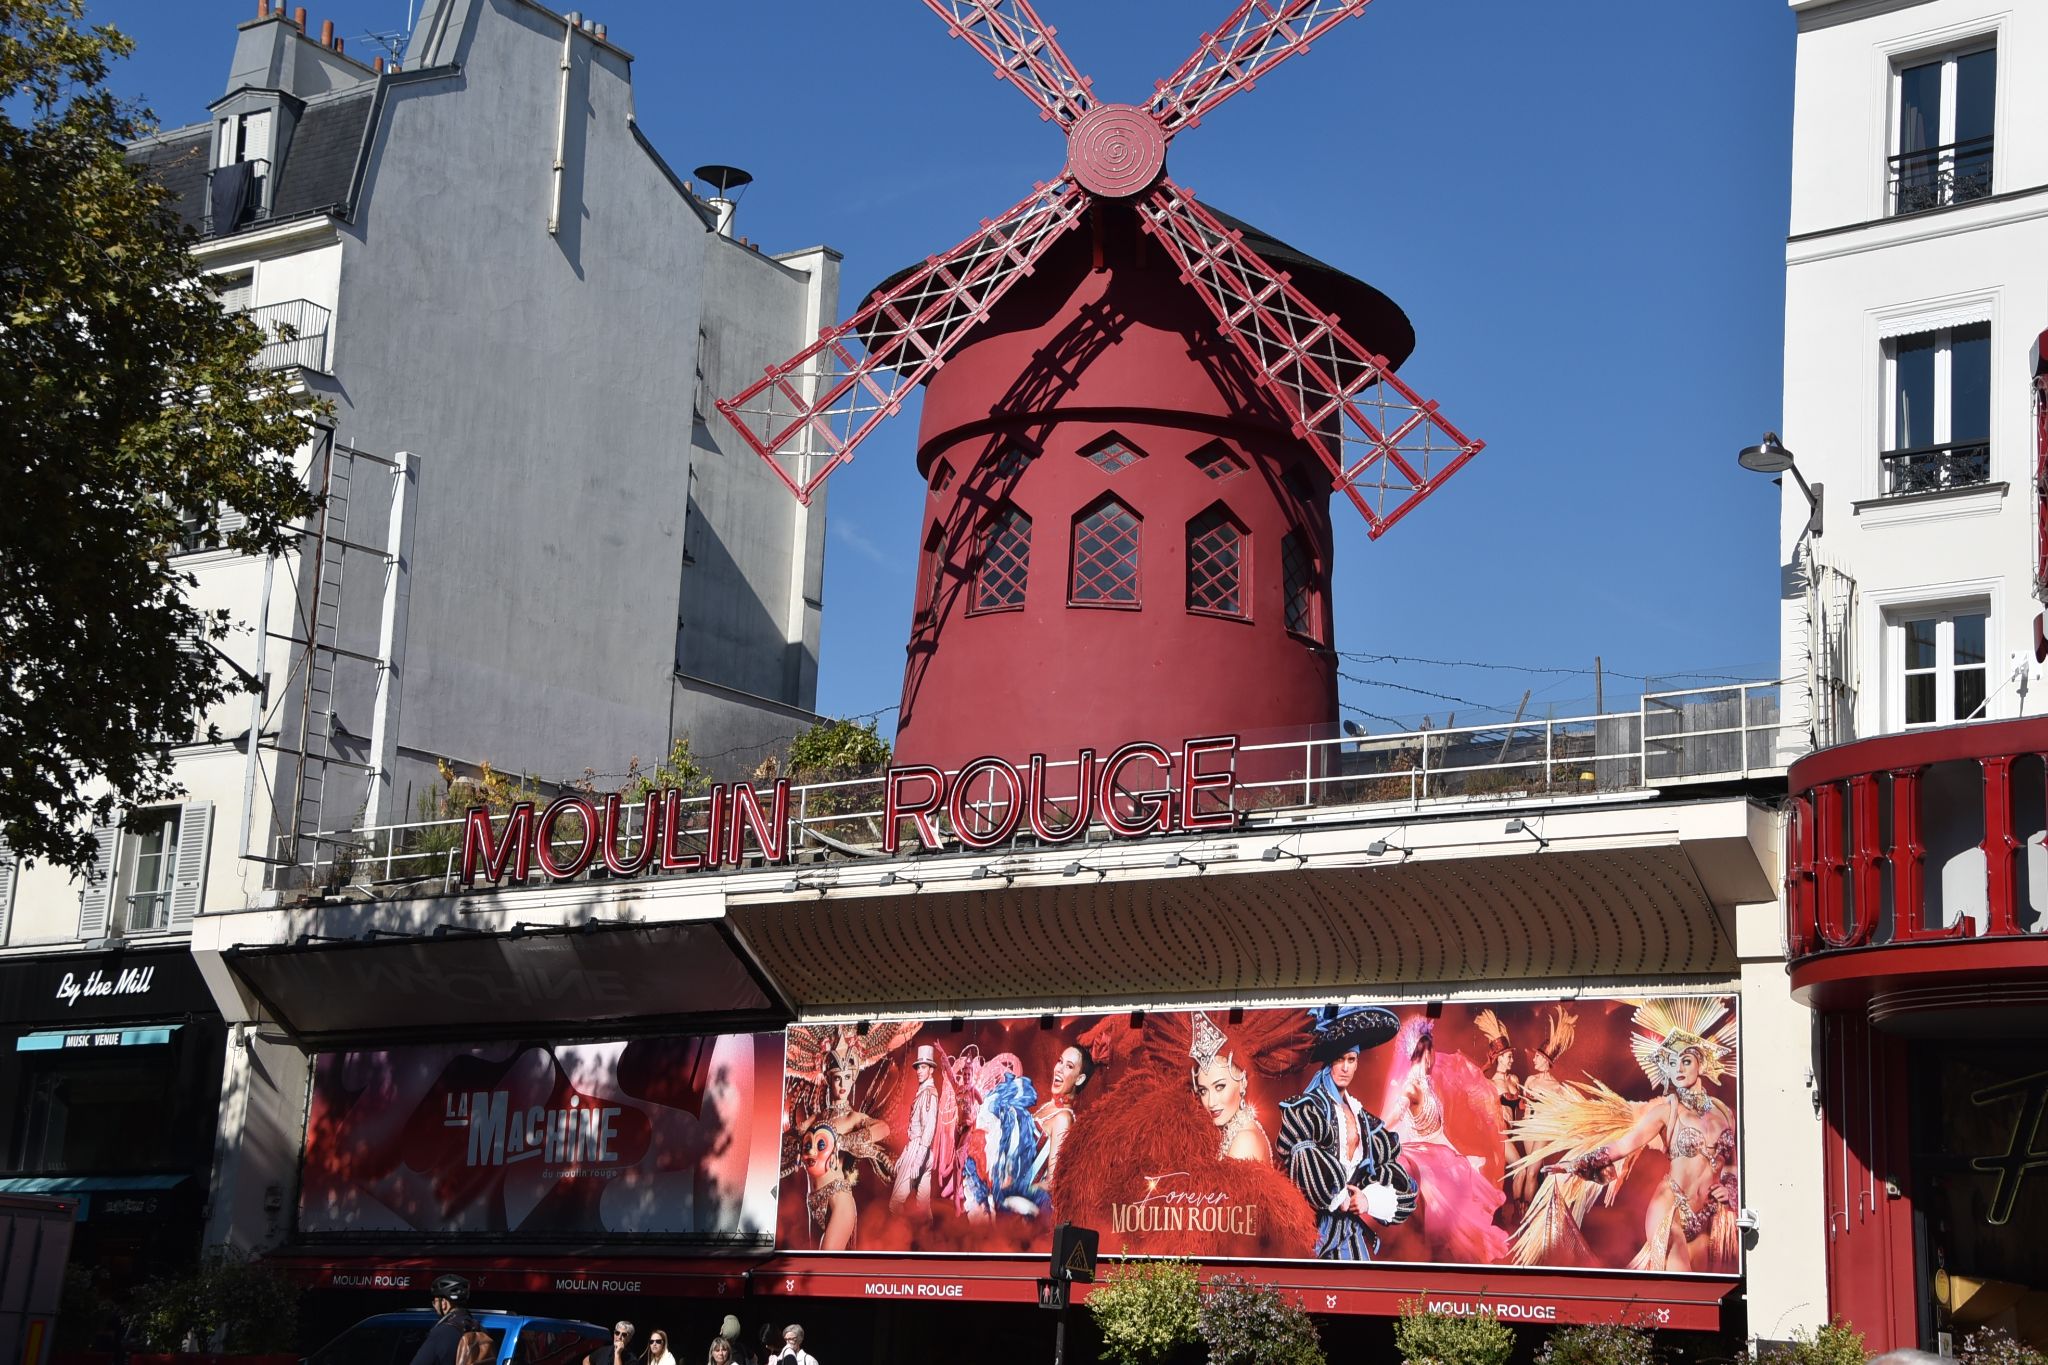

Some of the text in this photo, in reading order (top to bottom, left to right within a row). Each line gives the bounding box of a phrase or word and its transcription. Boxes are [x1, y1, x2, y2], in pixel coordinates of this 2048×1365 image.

[460, 734, 1241, 885] MOULIN ROUGE
[56, 966, 155, 1007] By the Mill
[66, 1034, 120, 1047] MUSIC VENUE
[446, 1092, 468, 1118] LA
[542, 1168, 618, 1179] du moulin rouge
[1133, 1172, 1230, 1214] Forever
[1111, 1203, 1183, 1234] MOULIN
[1188, 1204, 1257, 1236] ROUGE
[333, 1275, 410, 1287] MOULIN ROUGE
[556, 1279, 641, 1292] MOULIN ROUGE
[864, 1282, 963, 1297] MOULIN ROUGE
[1497, 1303, 1556, 1319] ROUGE
